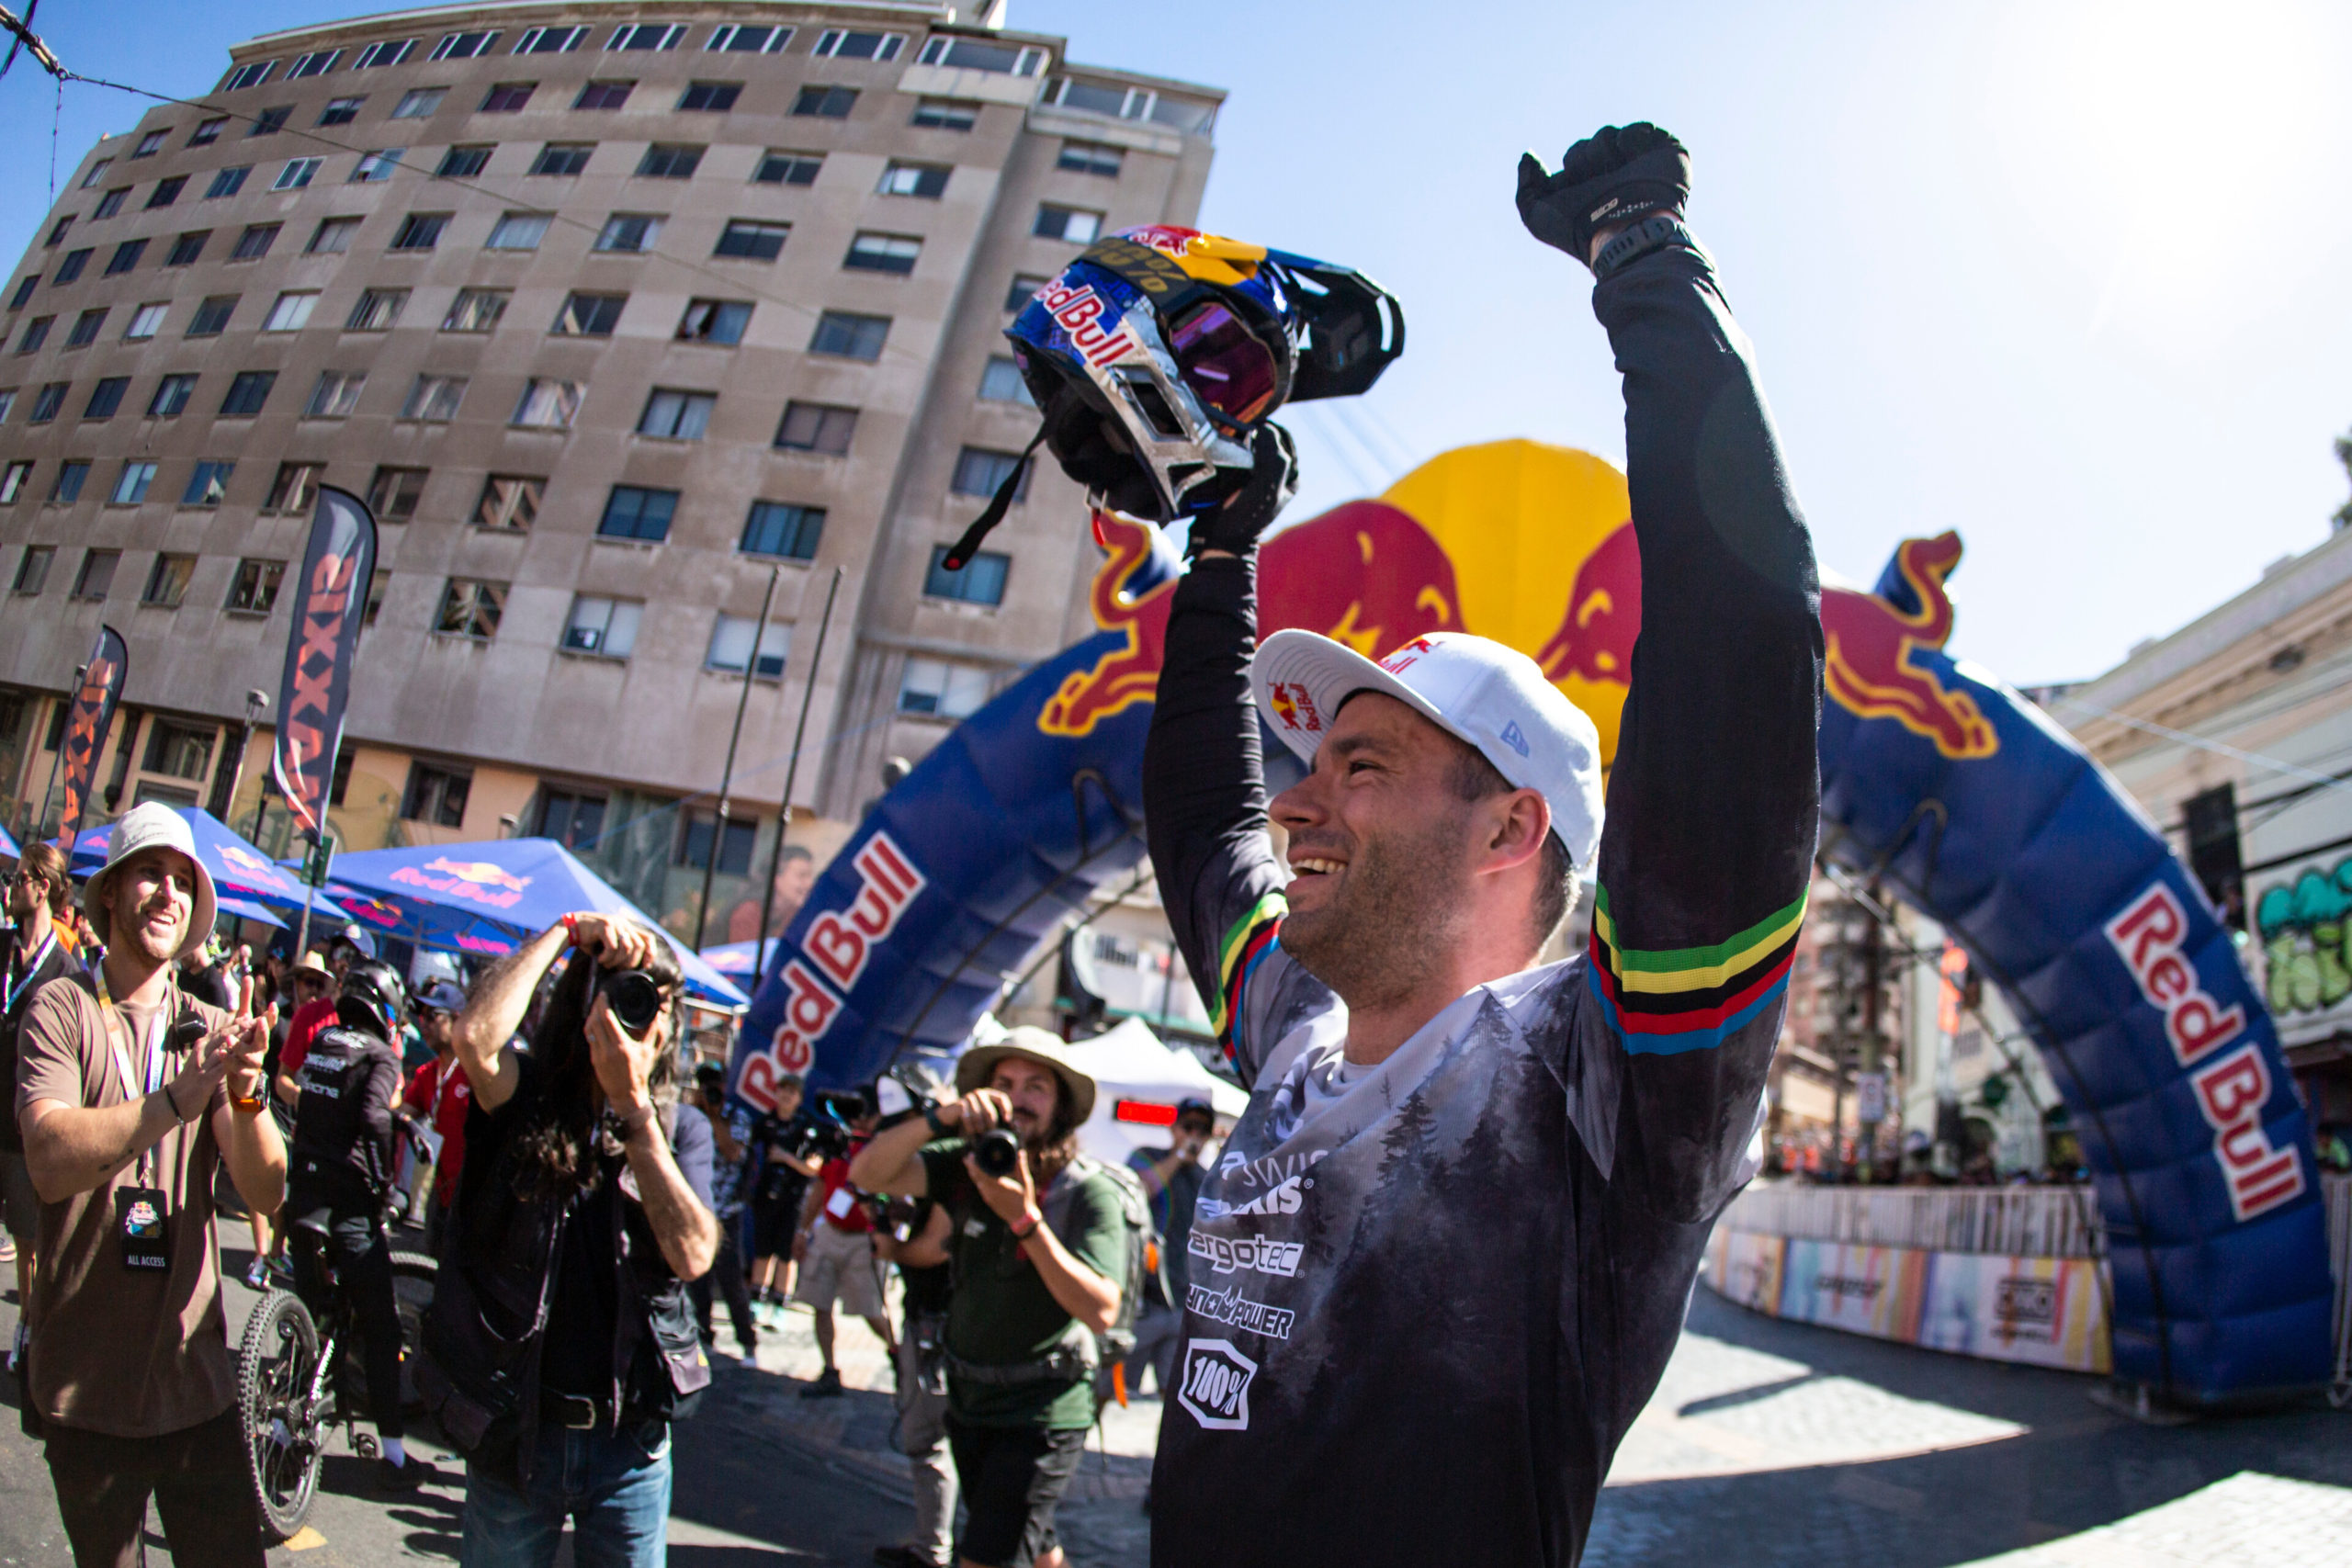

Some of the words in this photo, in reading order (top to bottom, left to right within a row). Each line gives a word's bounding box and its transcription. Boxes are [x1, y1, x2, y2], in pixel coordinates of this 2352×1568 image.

[1054, 292, 1136, 369] Bull
[1288, 683, 1313, 705] Bull
[1297, 705, 1322, 731] Red
[736, 957, 844, 1114] Red
[801, 829, 927, 994] Bull
[2103, 880, 2246, 1067] Red
[2188, 1041, 2306, 1223] Bull
[128, 1254, 140, 1265] ALL
[141, 1256, 165, 1267] ACCESS
[1228, 1298, 1295, 1340] POWER
[1187, 1356, 1248, 1416] 100%
